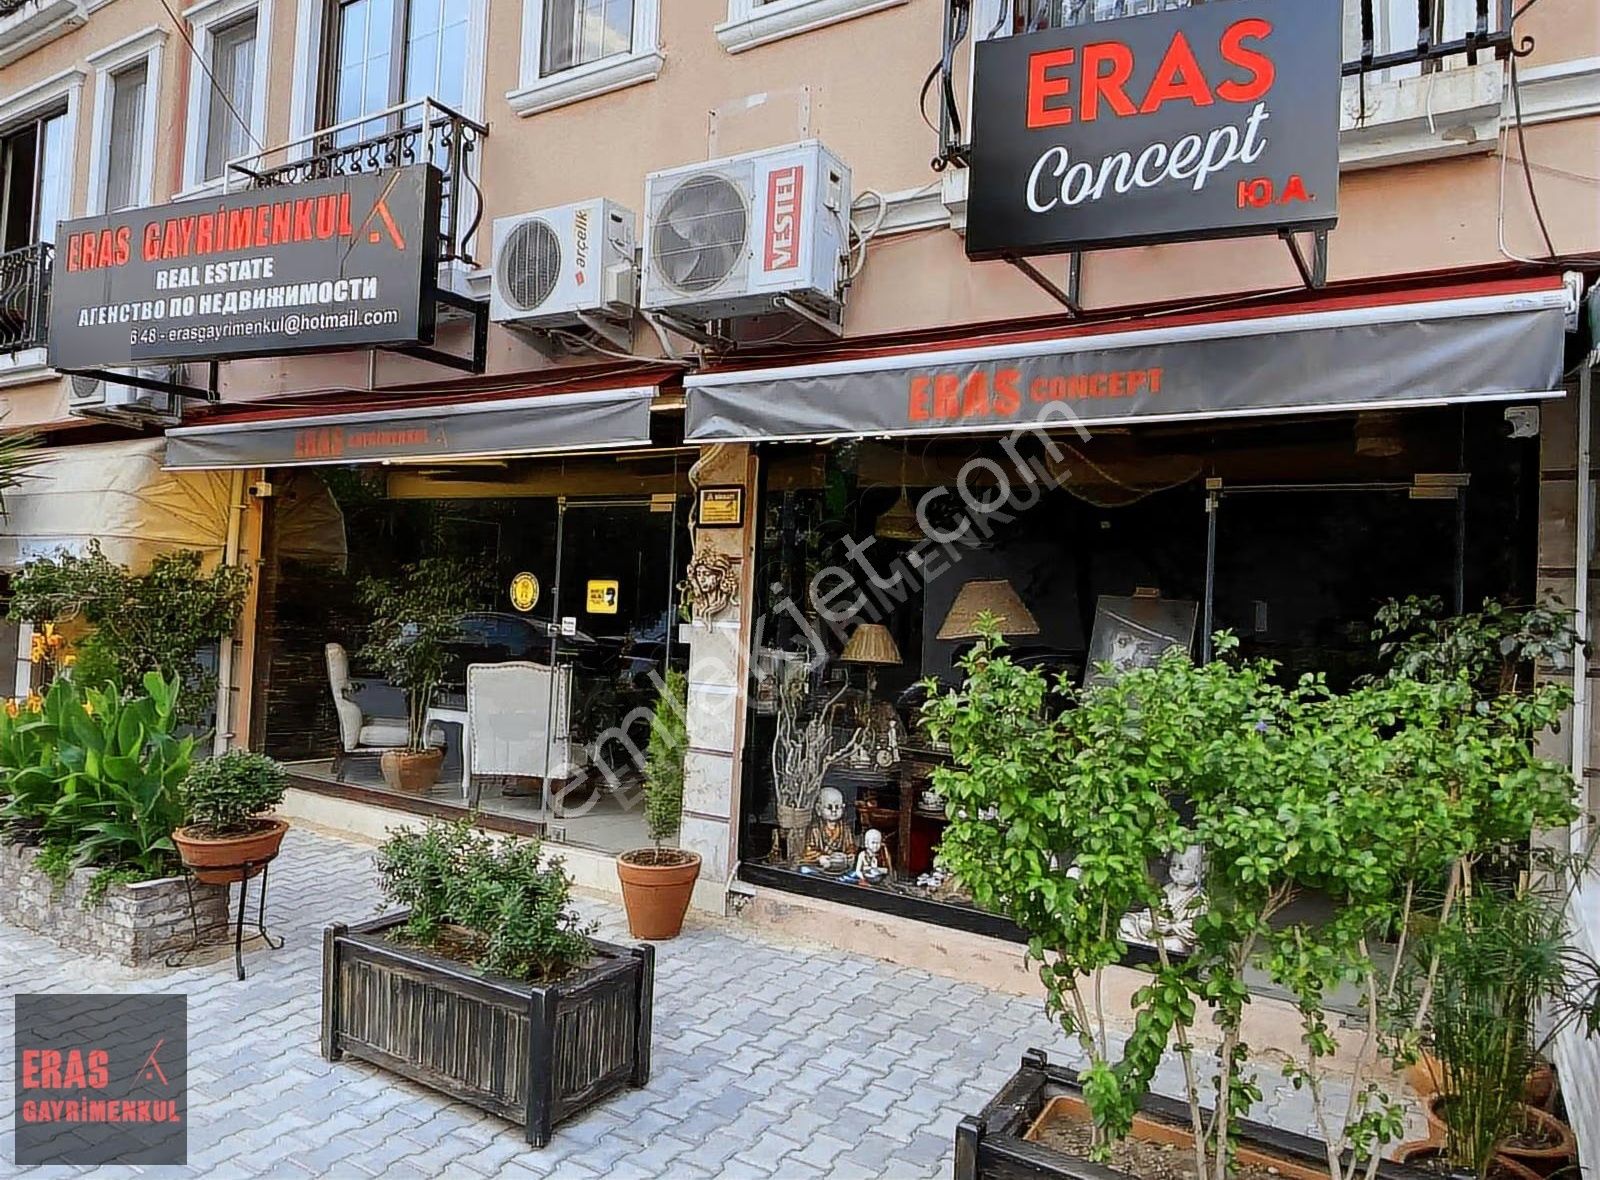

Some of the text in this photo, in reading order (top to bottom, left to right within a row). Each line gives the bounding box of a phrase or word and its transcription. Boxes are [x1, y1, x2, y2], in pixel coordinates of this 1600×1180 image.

[1026, 18, 1276, 128] ERAS
[1026, 101, 1270, 213] Concept
[66, 193, 353, 272] ERAS GAYRİMENKUL
[771, 168, 797, 270] VESTEL
[78, 277, 378, 327] АГЕНСТВО ПО НЕДВИЖИМОСТИ
[155, 257, 274, 290] REAL ESTATE
[169, 309, 398, 343] erasgayrimenkul@hotmail.com
[908, 367, 1164, 422] ERAS CONCEPT
